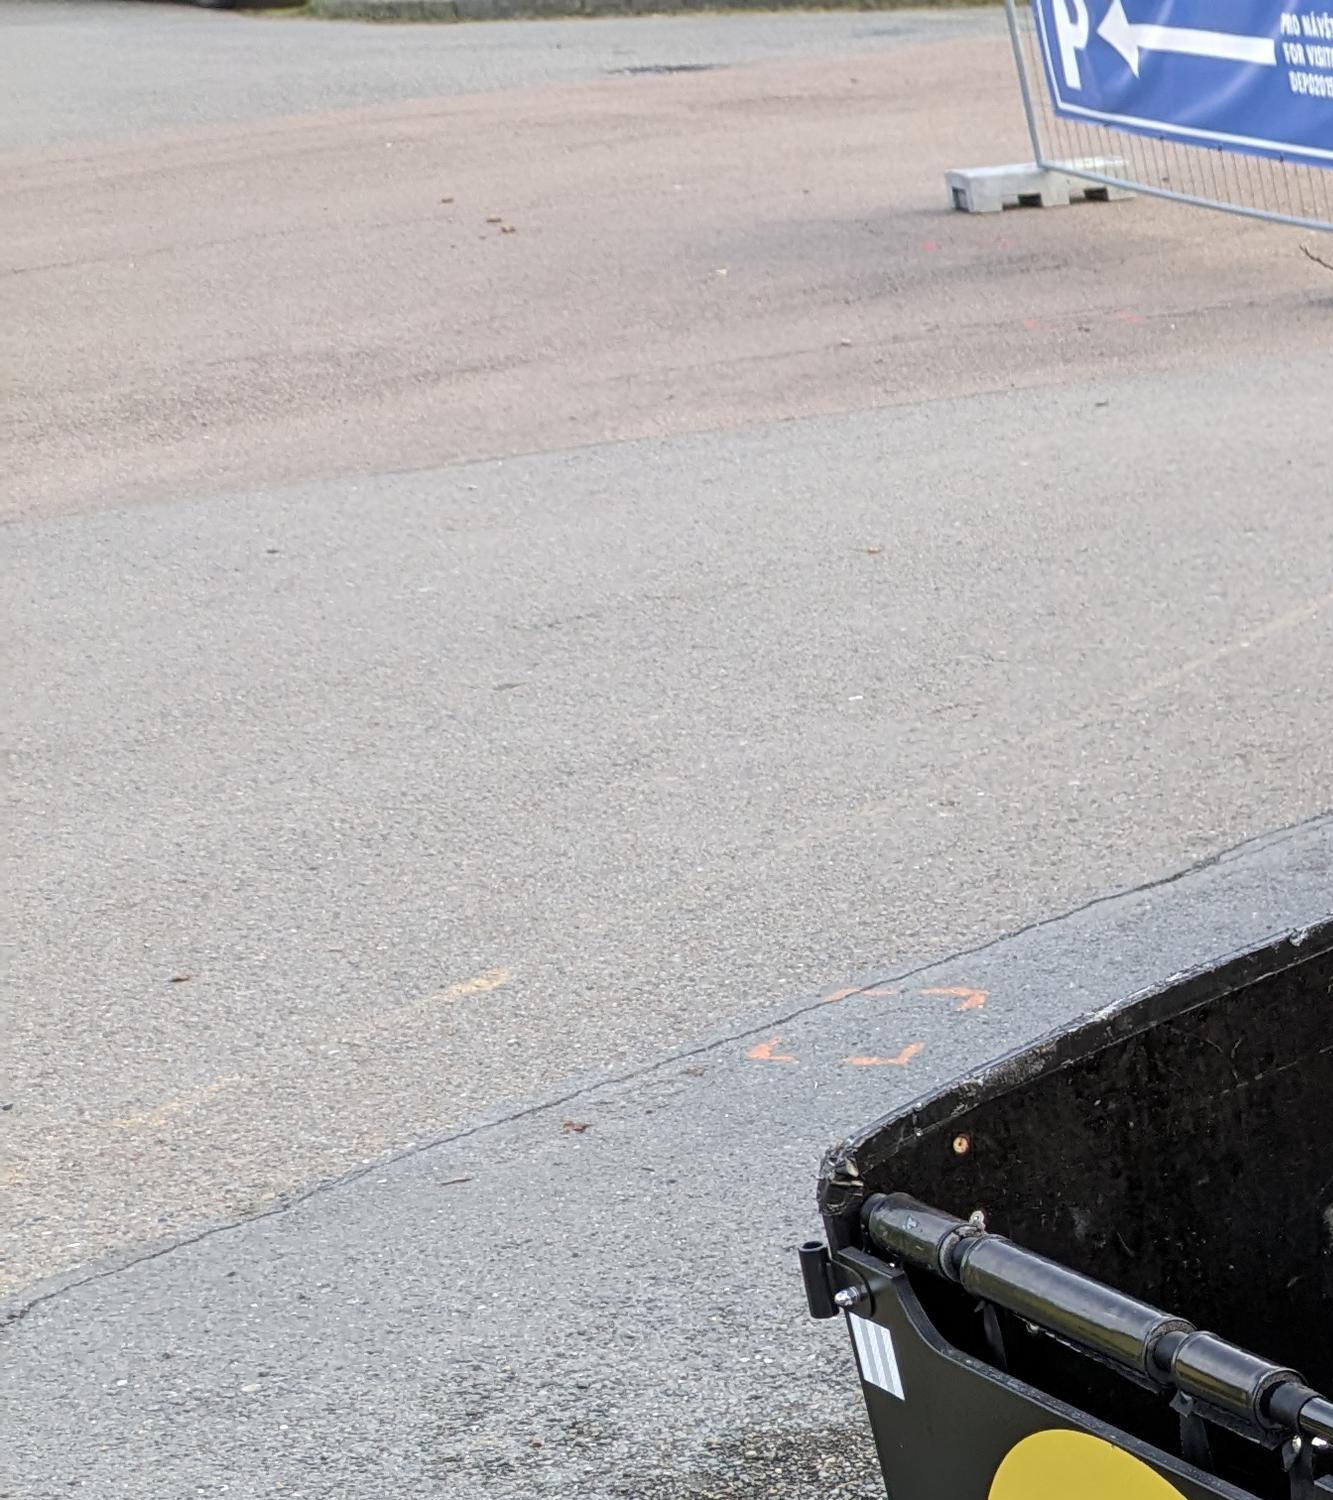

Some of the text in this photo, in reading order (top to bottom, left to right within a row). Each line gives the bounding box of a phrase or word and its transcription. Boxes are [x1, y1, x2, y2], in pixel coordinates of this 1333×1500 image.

[1280, 12, 1301, 36] PRO
[1052, 0, 1089, 91] P
[1282, 42, 1306, 66] FOR
